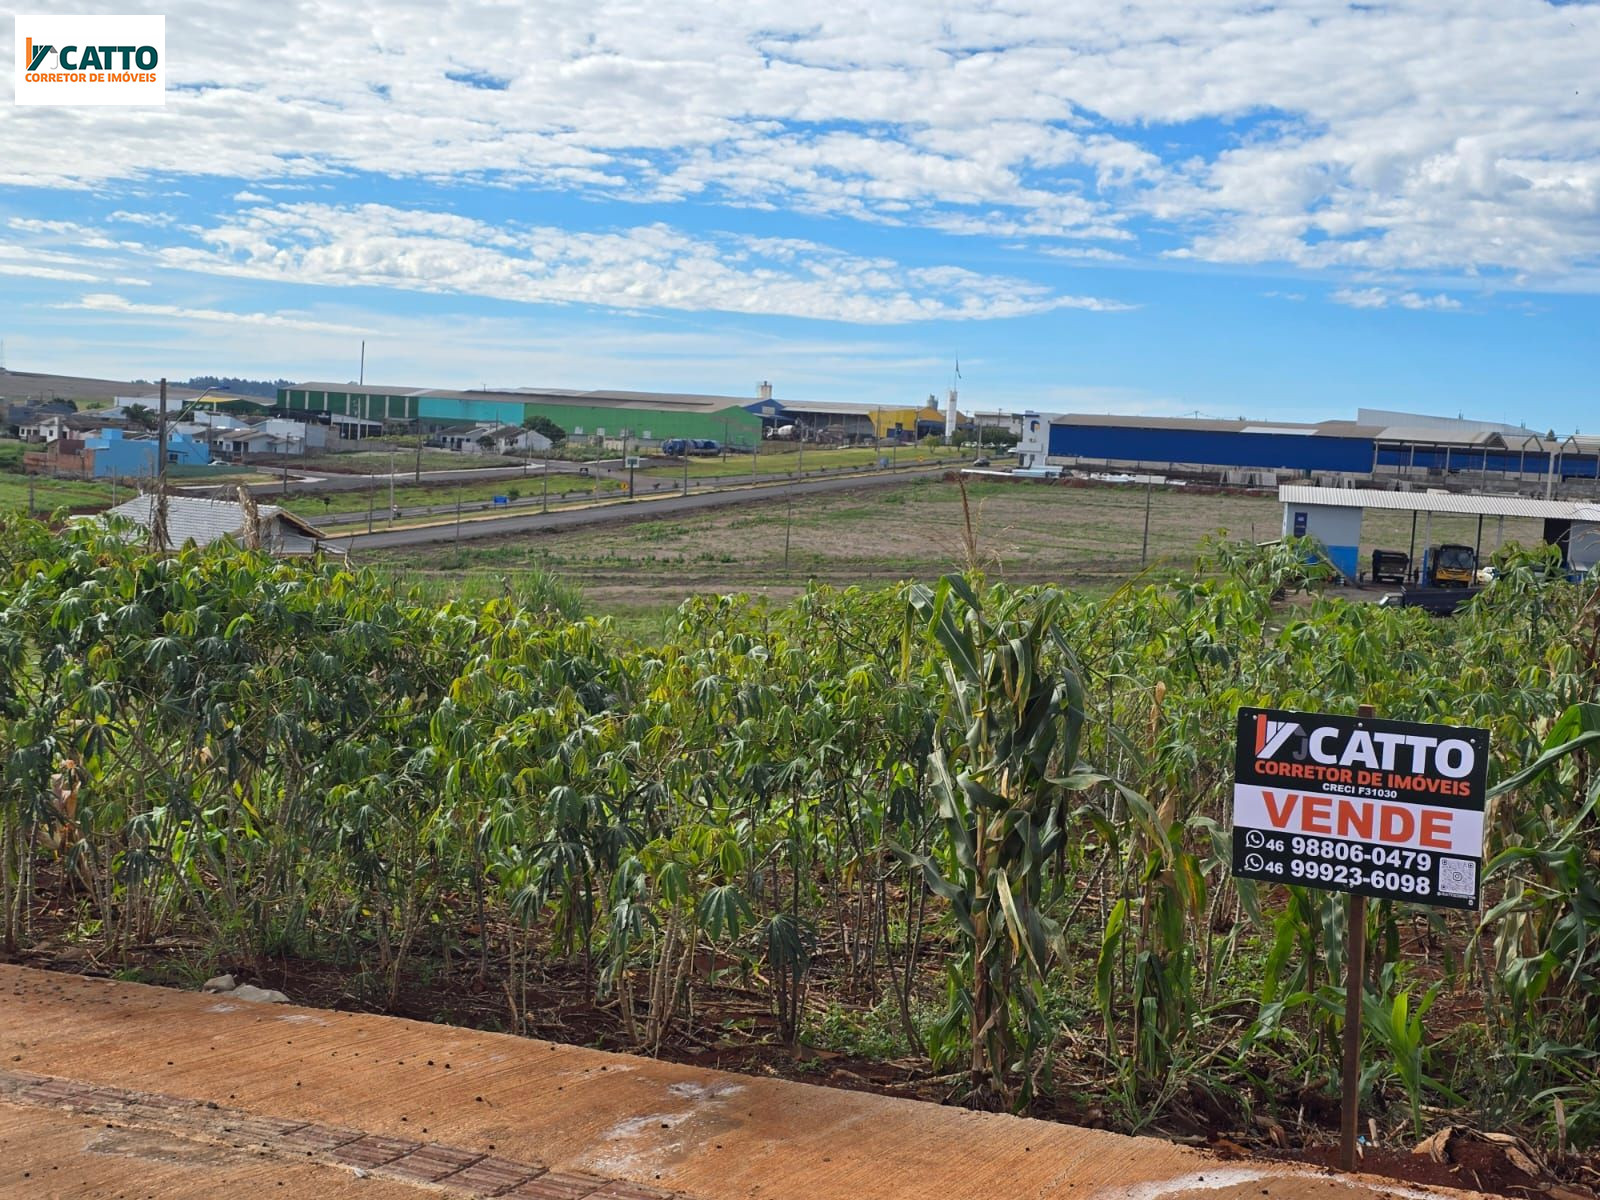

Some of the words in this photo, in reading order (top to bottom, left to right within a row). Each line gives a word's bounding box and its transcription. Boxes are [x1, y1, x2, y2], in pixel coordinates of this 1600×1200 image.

[1308, 727, 1475, 778] CATTO
[1254, 760, 1353, 785] CORRETOR
[1357, 771, 1383, 788] DE
[1388, 774, 1471, 797] IMÓVEIS
[1322, 782, 1356, 795] CRECI
[1358, 786, 1398, 799] F31030
[1261, 791, 1453, 850] VENDE
[1265, 839, 1285, 853] 46
[1291, 836, 1432, 872] 98806-0479
[1264, 861, 1284, 875] 46
[1290, 860, 1431, 895] 99923-6098
